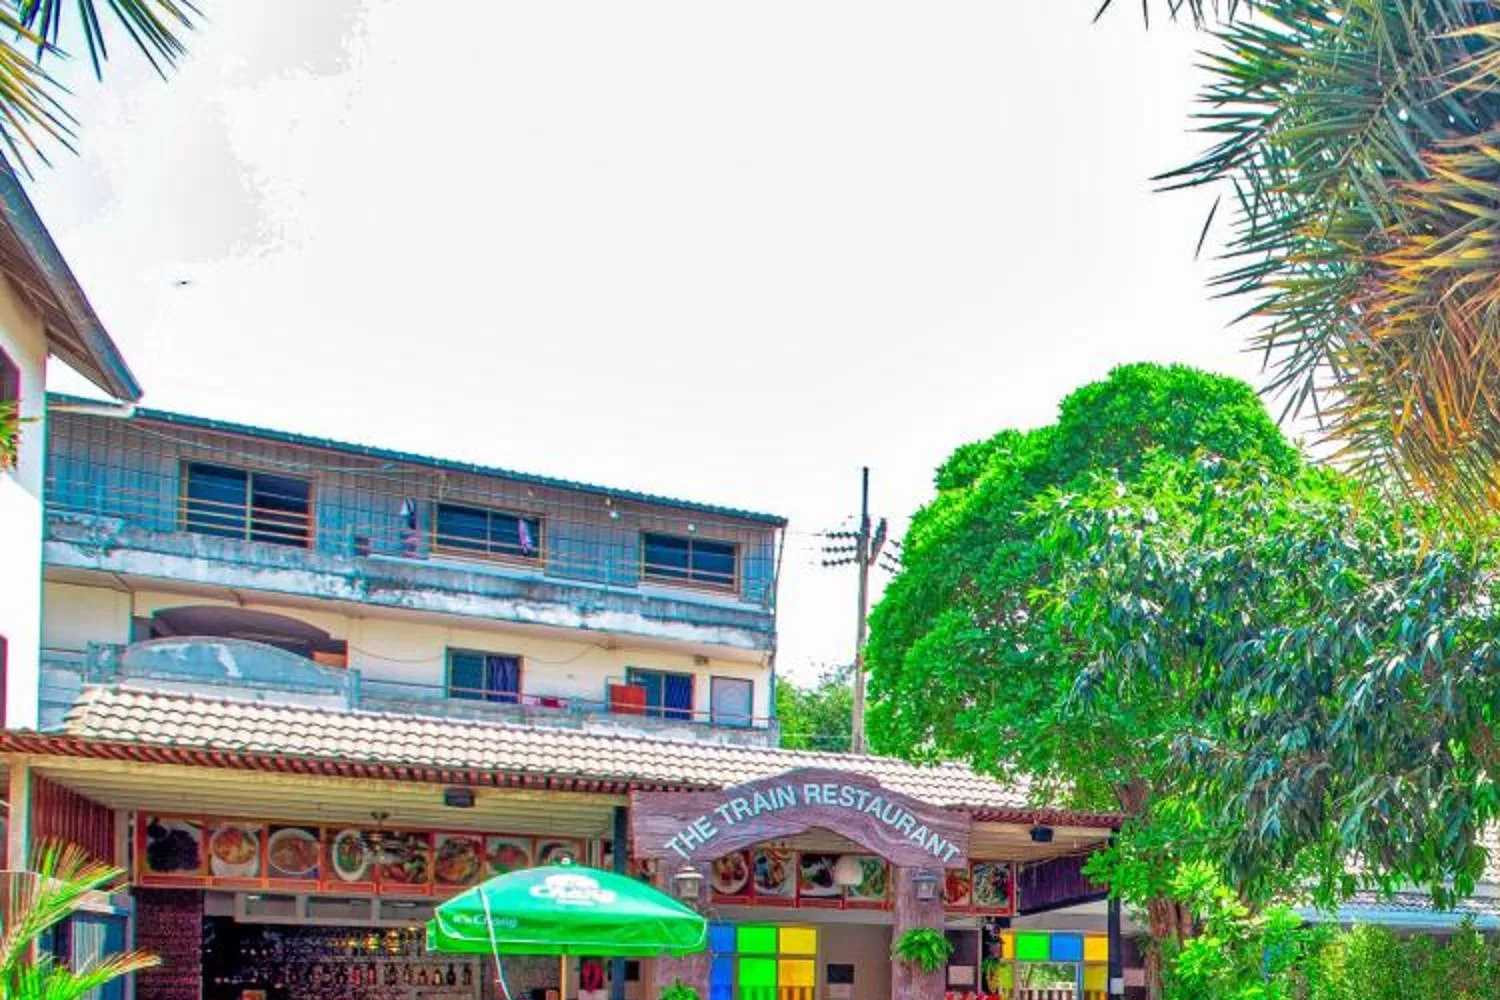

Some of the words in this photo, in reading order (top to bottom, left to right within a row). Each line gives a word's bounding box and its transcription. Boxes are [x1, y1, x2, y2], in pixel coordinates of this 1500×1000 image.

[664, 816, 718, 861] THE
[715, 784, 799, 826] TRAIN
[803, 782, 960, 864] RESTAURANT
